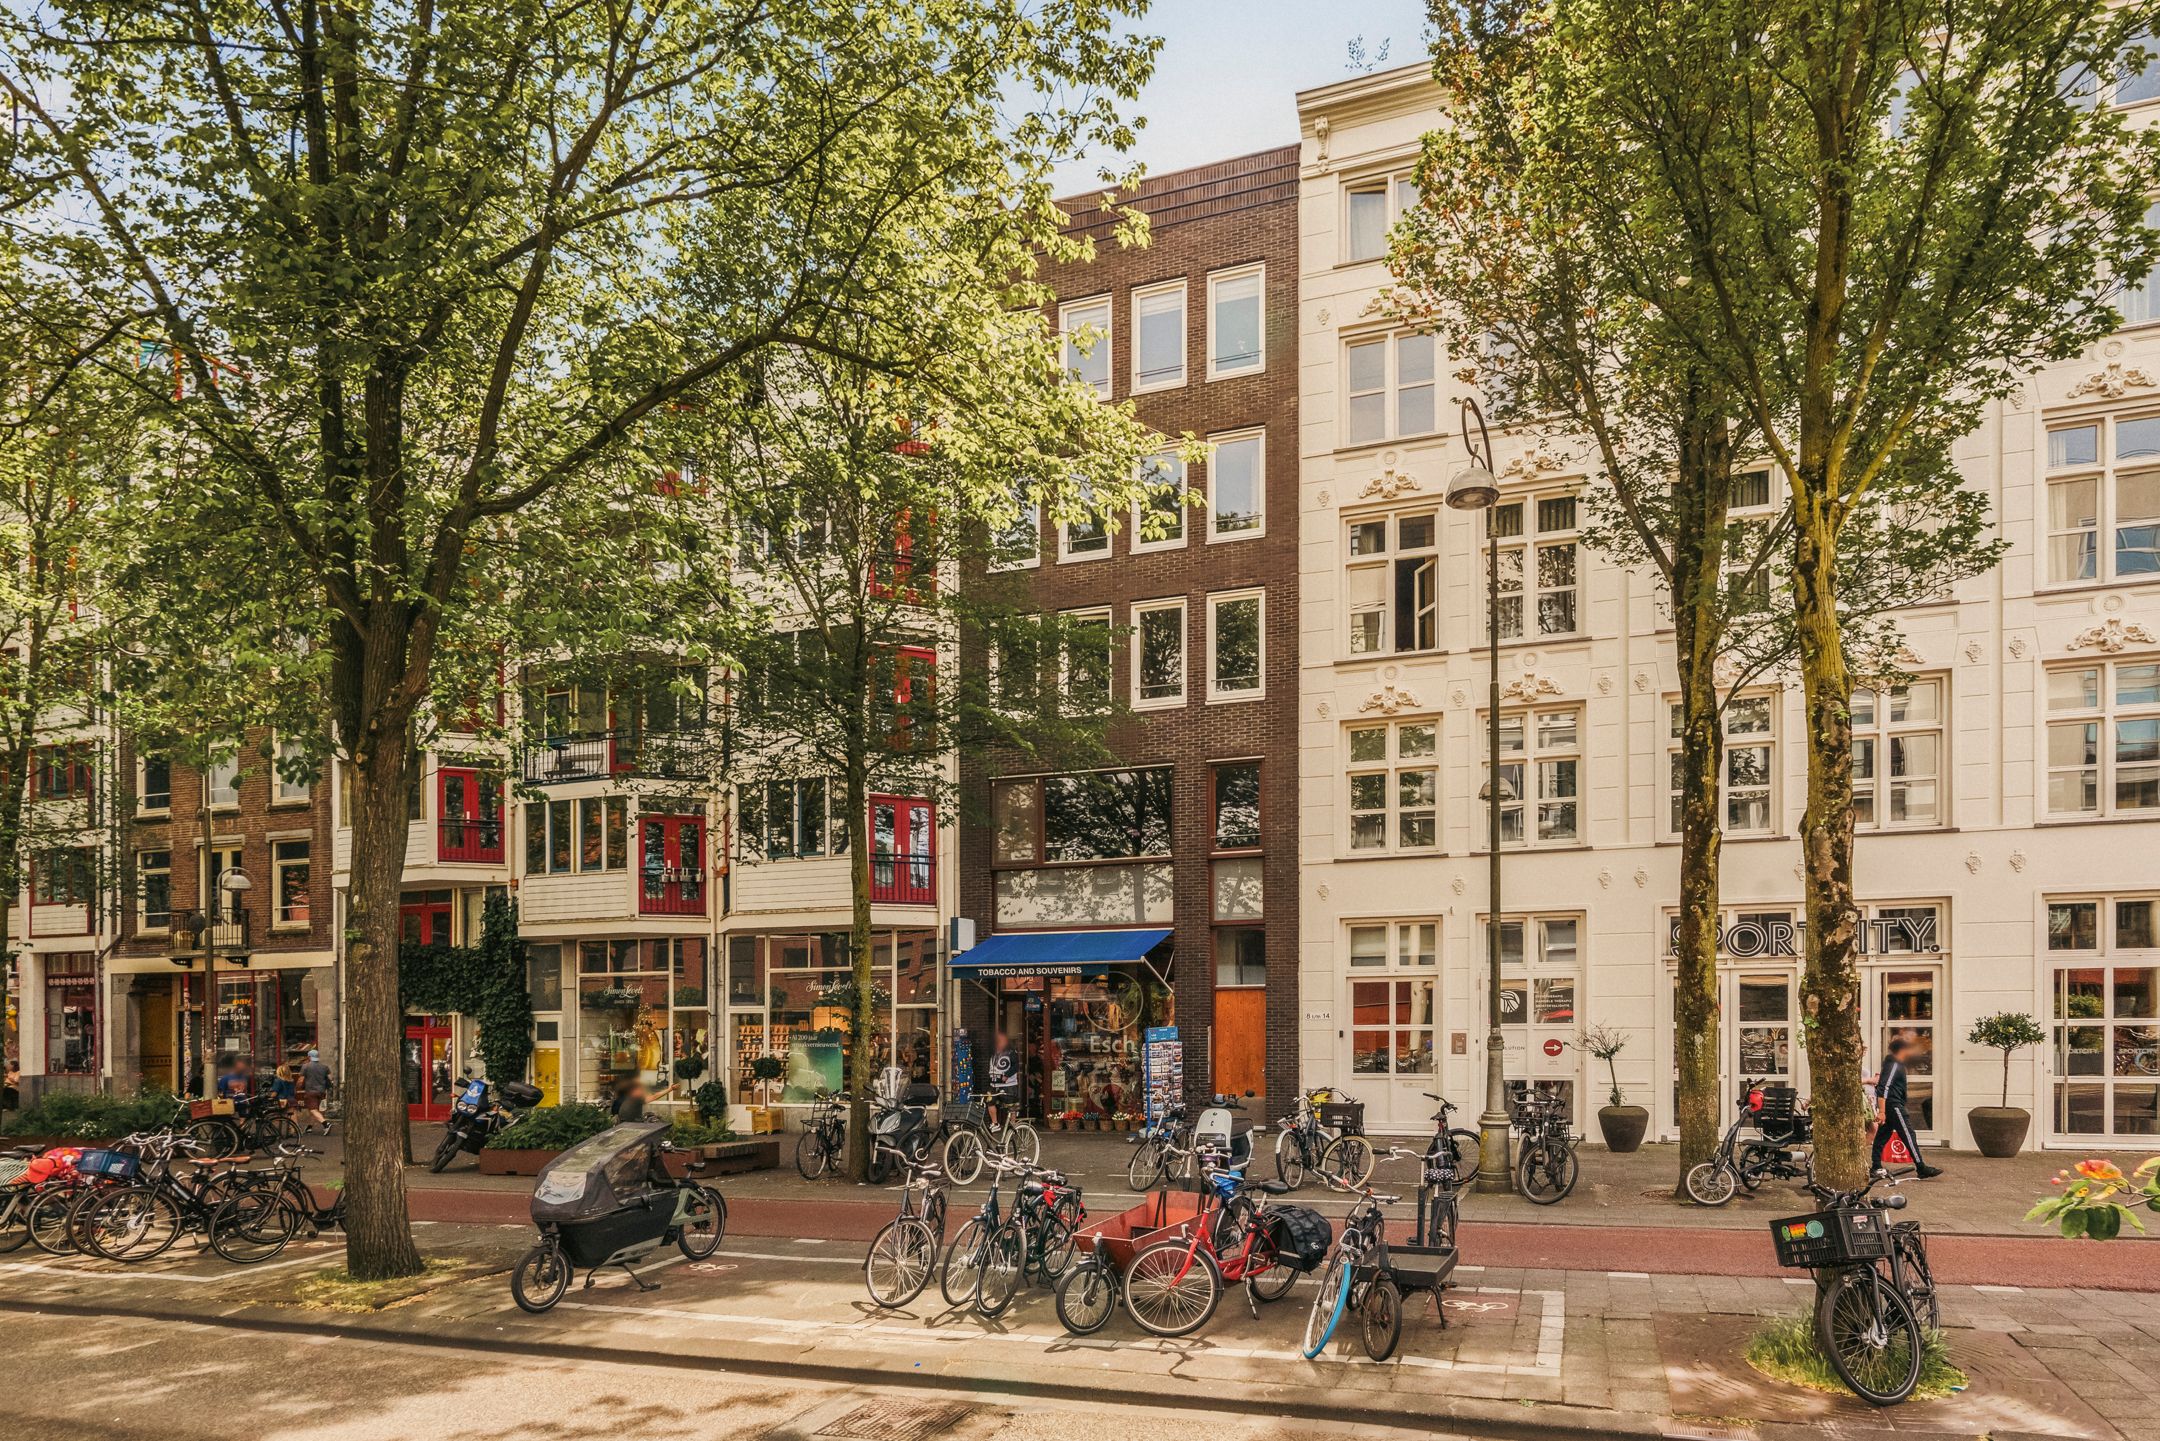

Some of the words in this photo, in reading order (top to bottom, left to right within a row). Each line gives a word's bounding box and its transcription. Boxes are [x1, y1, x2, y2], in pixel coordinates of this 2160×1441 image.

[1671, 916, 1940, 957] ORITY.
[978, 968, 1016, 976] TOBACCO
[1018, 968, 1035, 976] AND
[1036, 966, 1082, 975] SOUVENIRS
[1090, 1035, 1135, 1053] Esch
